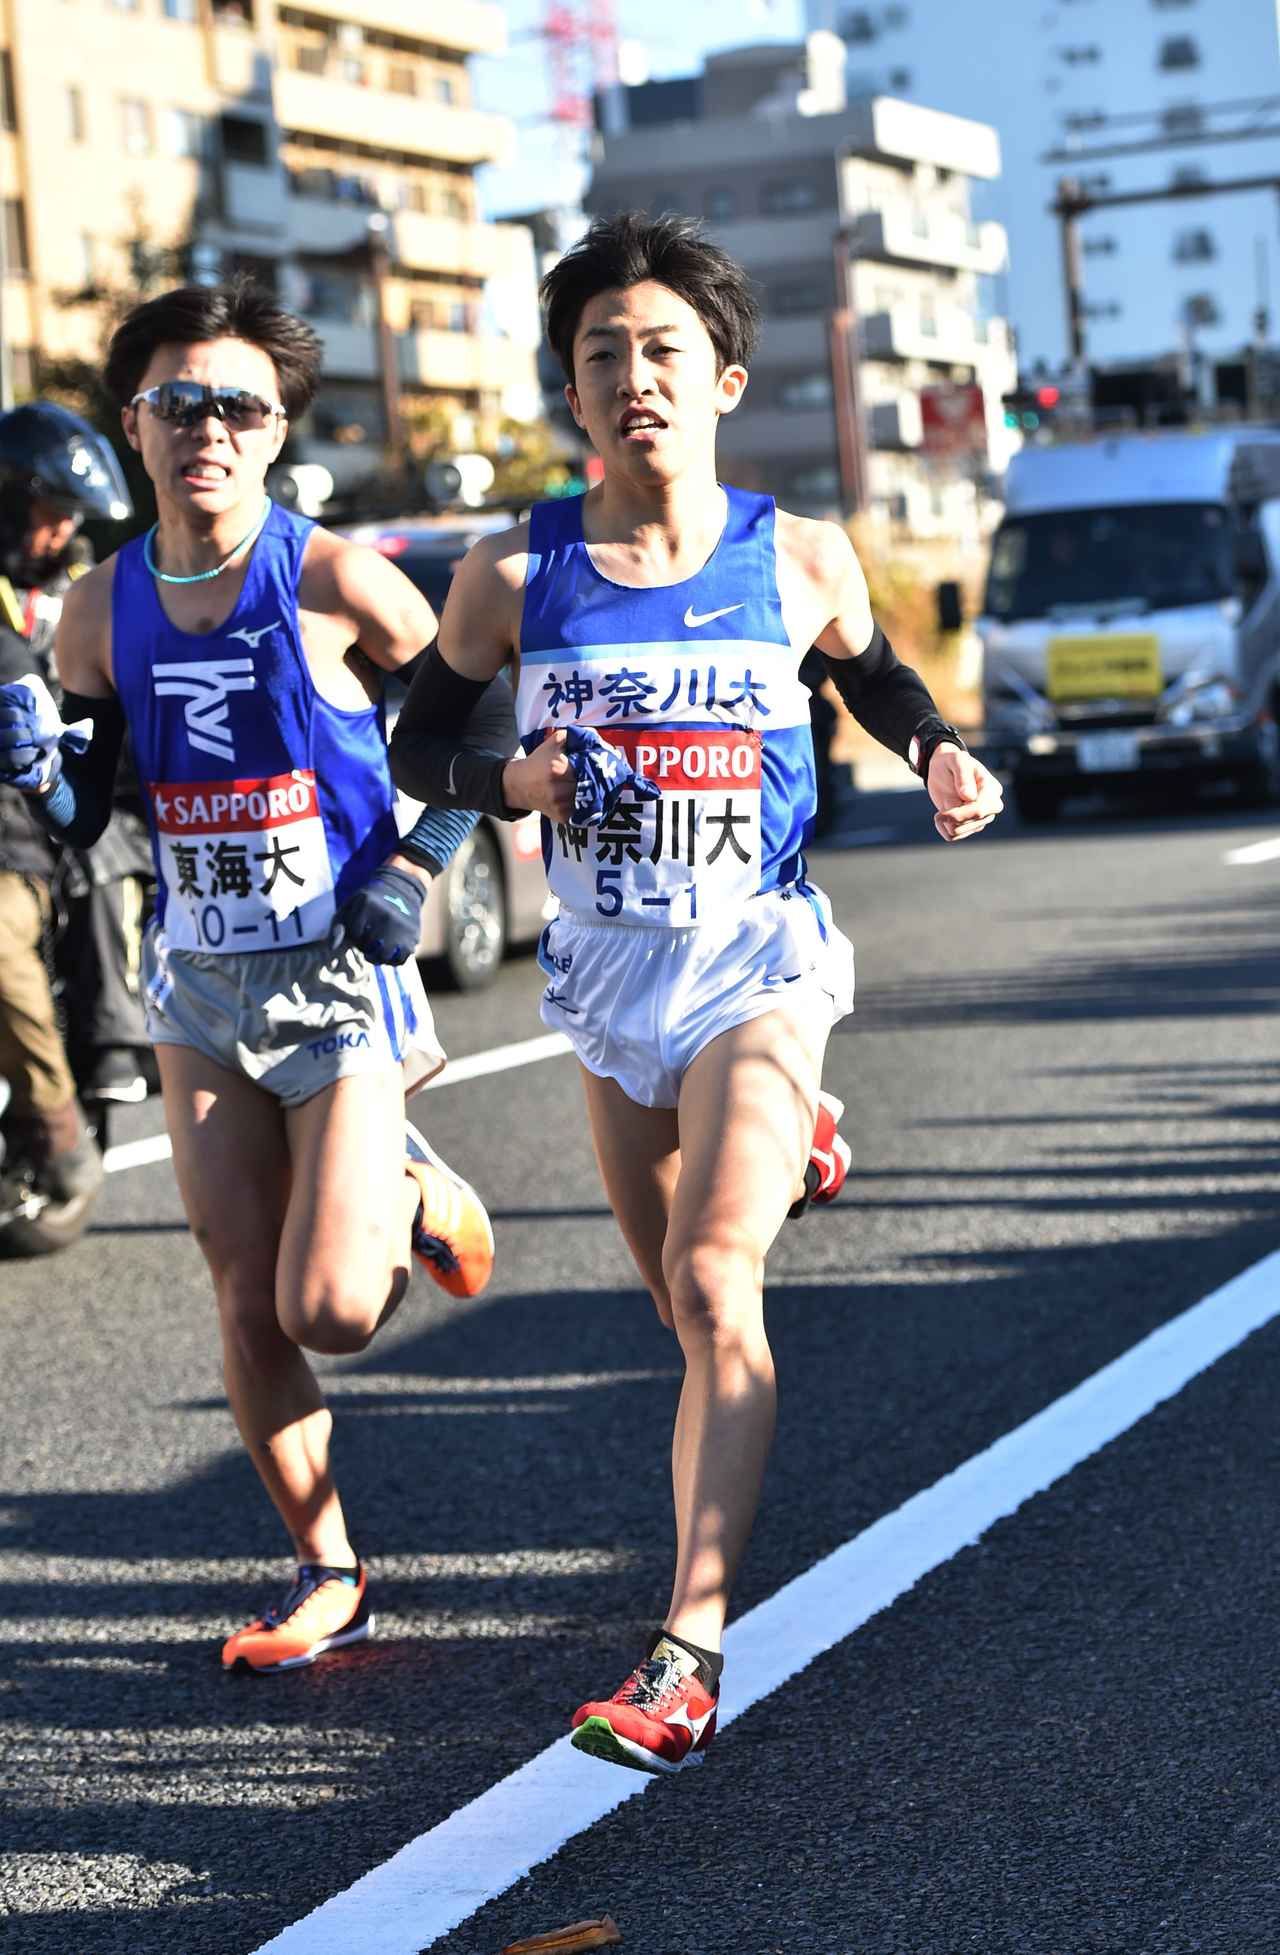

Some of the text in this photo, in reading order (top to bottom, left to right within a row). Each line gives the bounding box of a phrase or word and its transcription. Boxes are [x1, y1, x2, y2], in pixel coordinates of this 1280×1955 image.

[543, 666, 771, 719] 神奈川大
[613, 745, 755, 778] PPORO
[173, 783, 310, 825] SAPPORO
[169, 836, 305, 899] 東海大
[191, 904, 304, 947] 10-11
